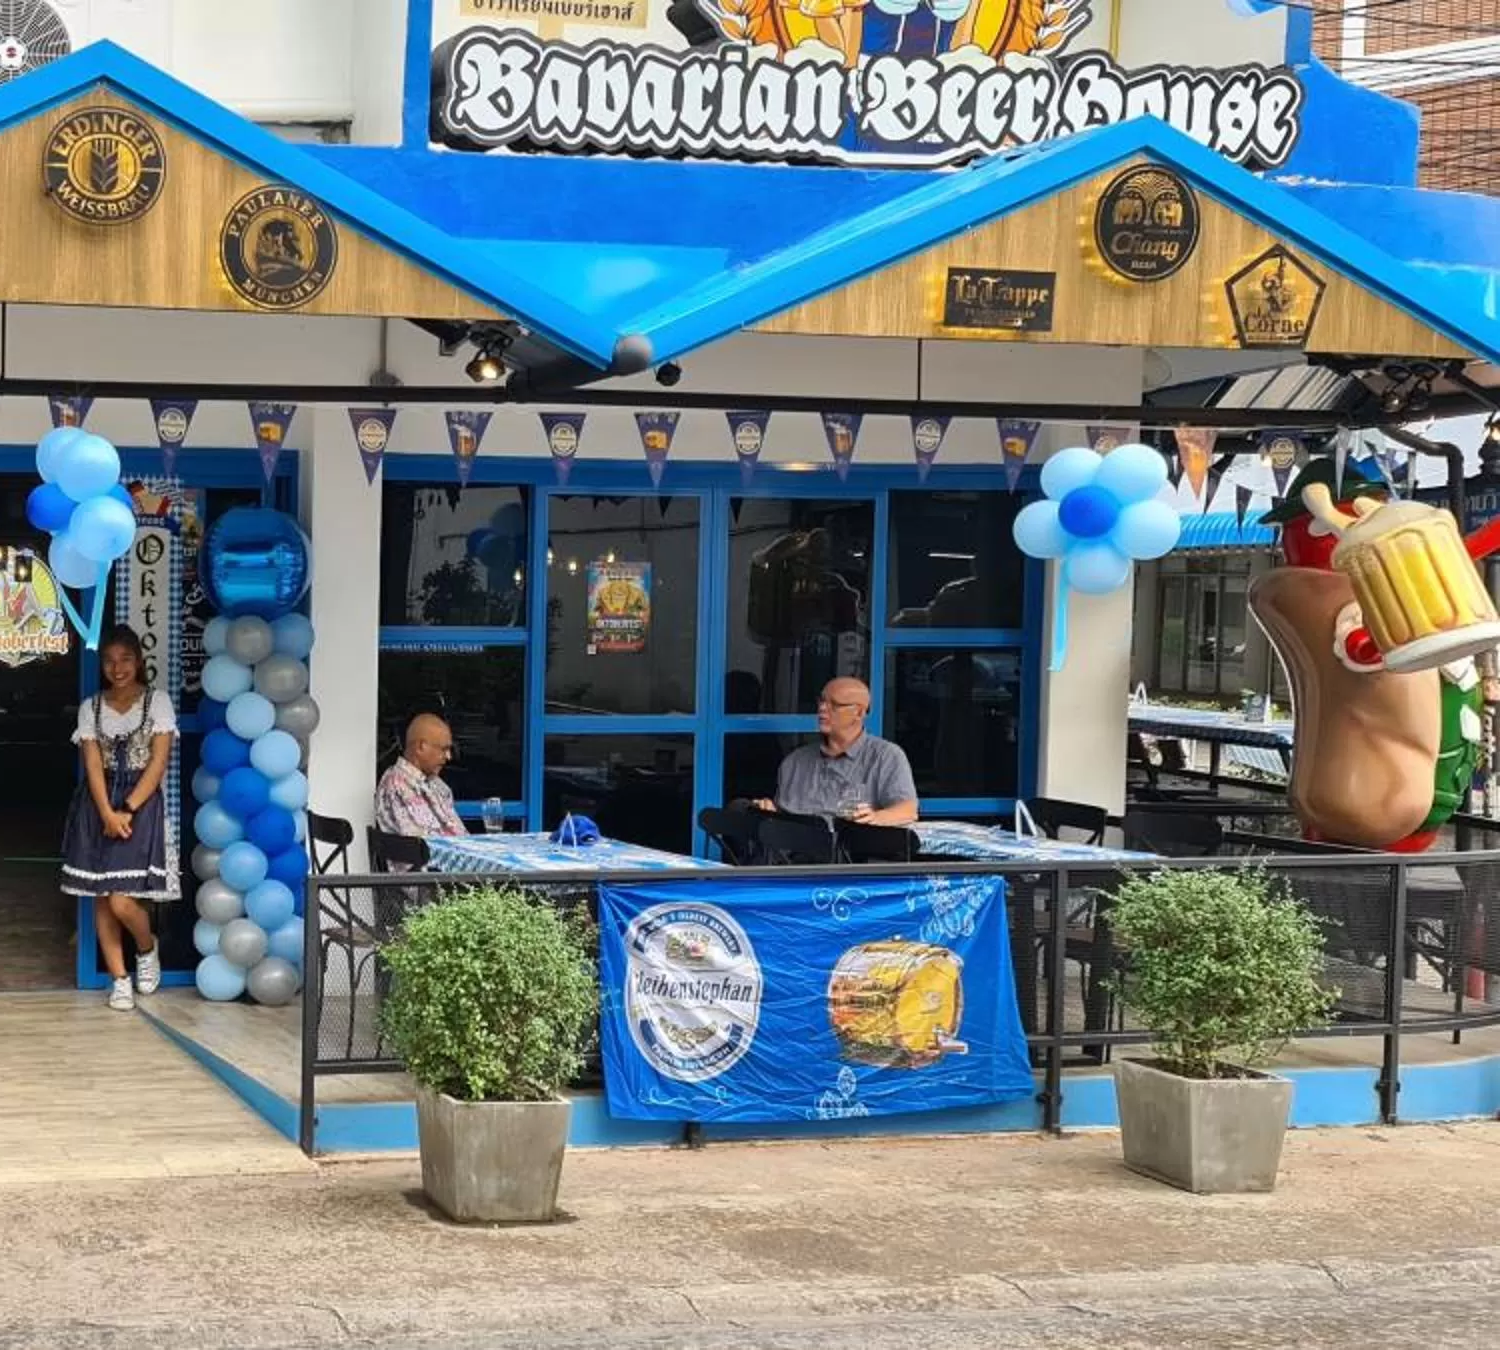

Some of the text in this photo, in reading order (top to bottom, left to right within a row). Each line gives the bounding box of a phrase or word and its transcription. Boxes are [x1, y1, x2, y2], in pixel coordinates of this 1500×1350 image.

[456, 42, 1297, 155] Bavarian Beer House
[52, 113, 157, 160] ERDINGER
[228, 191, 323, 237] PAULANER
[1111, 231, 1180, 260] Chang
